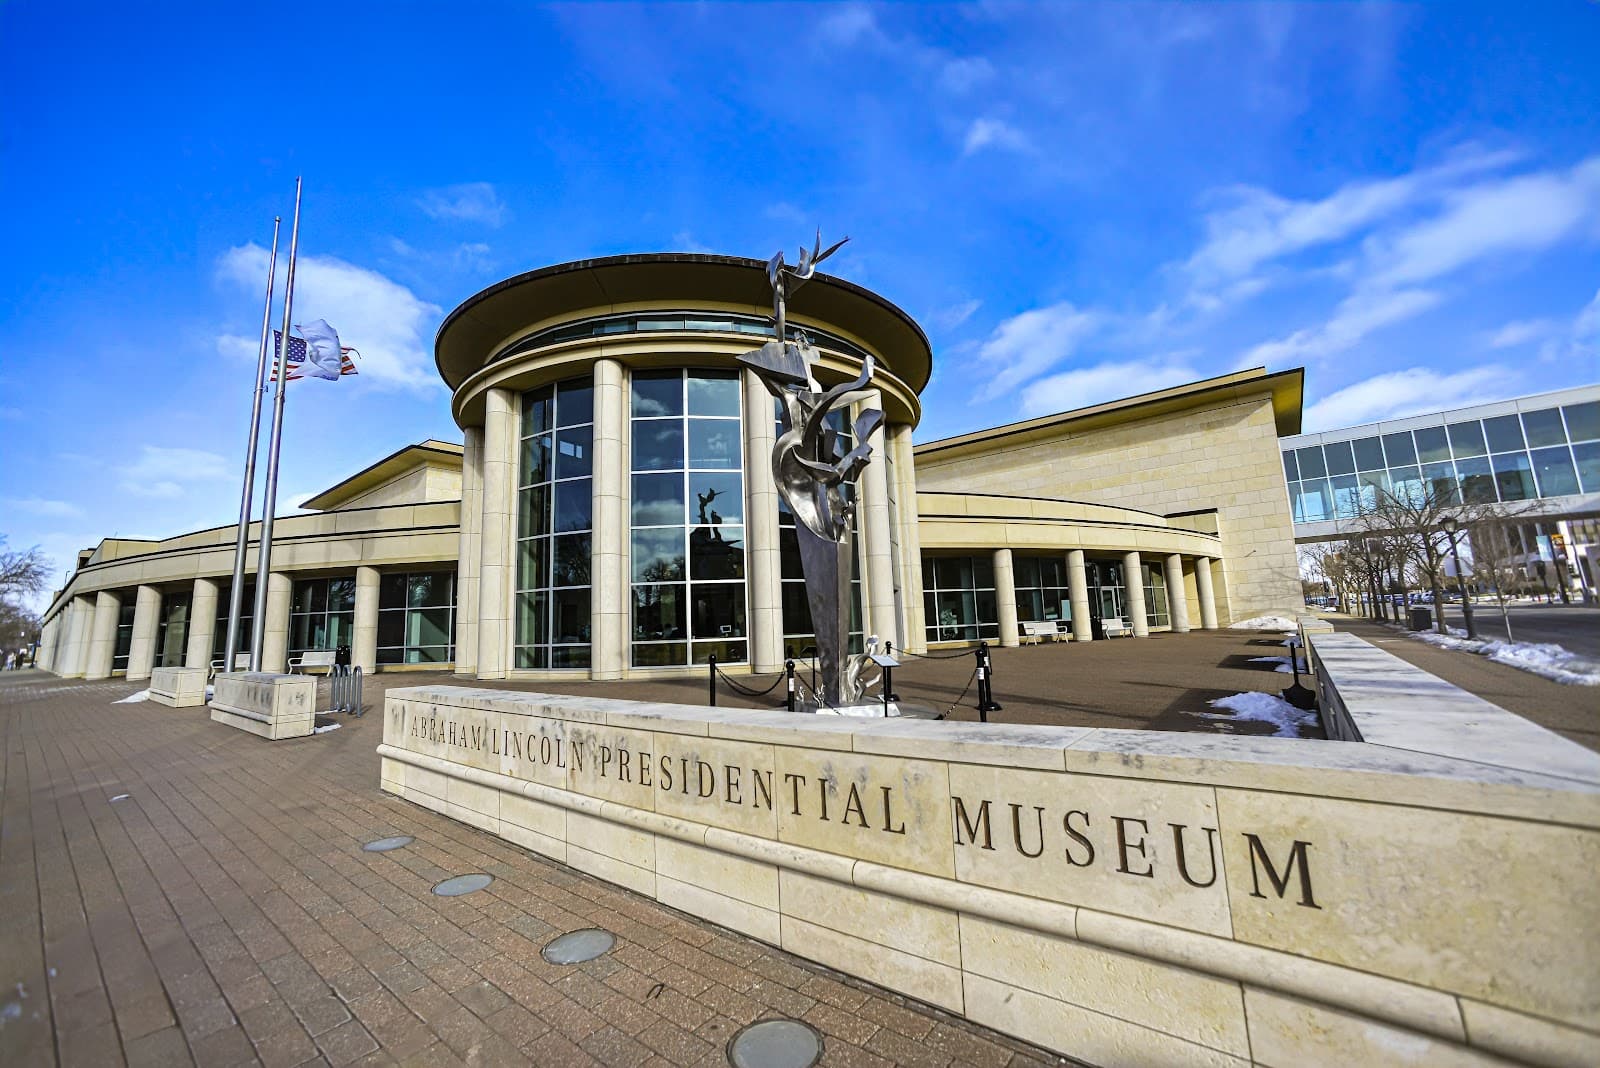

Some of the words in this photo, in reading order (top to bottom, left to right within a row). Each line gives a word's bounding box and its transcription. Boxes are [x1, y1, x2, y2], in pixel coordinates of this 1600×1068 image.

[411, 715, 481, 750] ABRAHAM
[492, 728, 585, 773] LINCOLN
[600, 745, 906, 835] PRESIDENTIAL
[951, 796, 1322, 910] MUSEUM
